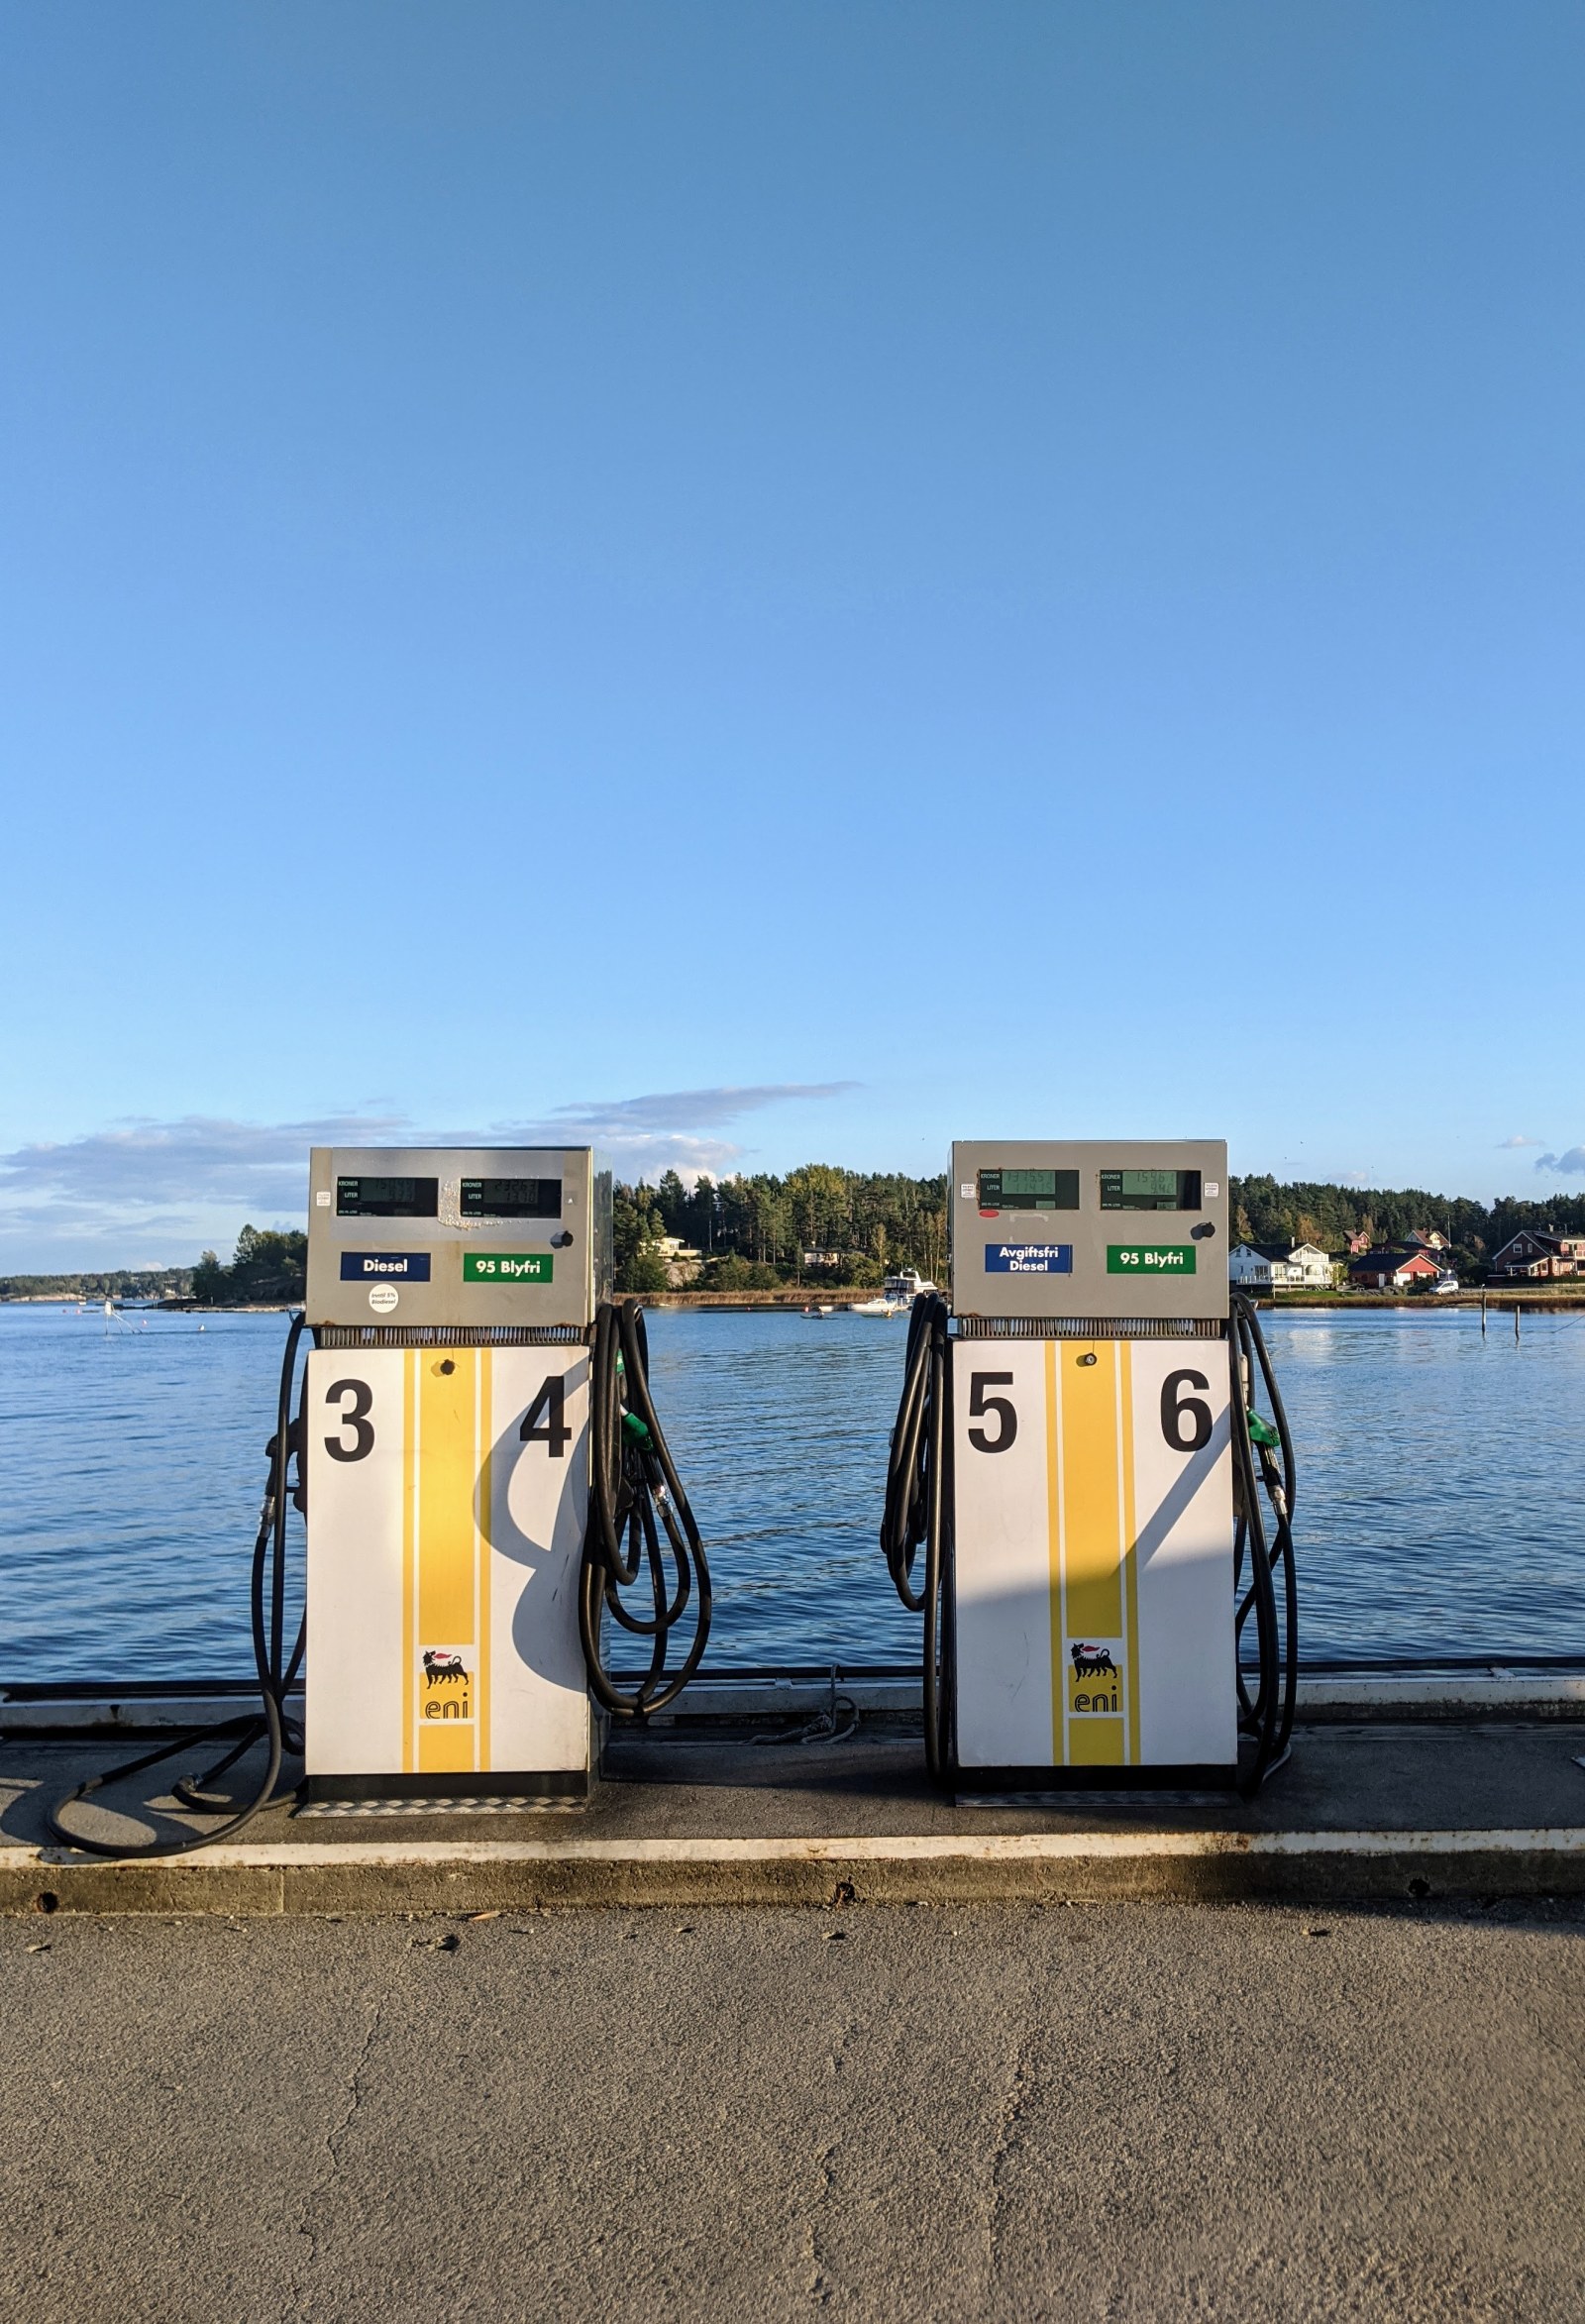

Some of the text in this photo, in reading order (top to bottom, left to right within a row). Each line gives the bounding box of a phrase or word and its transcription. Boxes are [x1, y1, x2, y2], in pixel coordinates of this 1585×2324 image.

[363, 1258, 408, 1273] Diesel
[1000, 1246, 1059, 1261] Avgiftsfri
[1009, 1260, 1048, 1271] Diesel
[1120, 1252, 1184, 1268] 95 Blyfri
[476, 1260, 541, 1277] 95 Blyfri
[324, 1378, 375, 1462] 3
[519, 1375, 573, 1458] 4
[968, 1371, 1017, 1454] 5
[1160, 1369, 1214, 1452] 6
[425, 1692, 469, 1719] eni
[1074, 1686, 1118, 1713] eni
